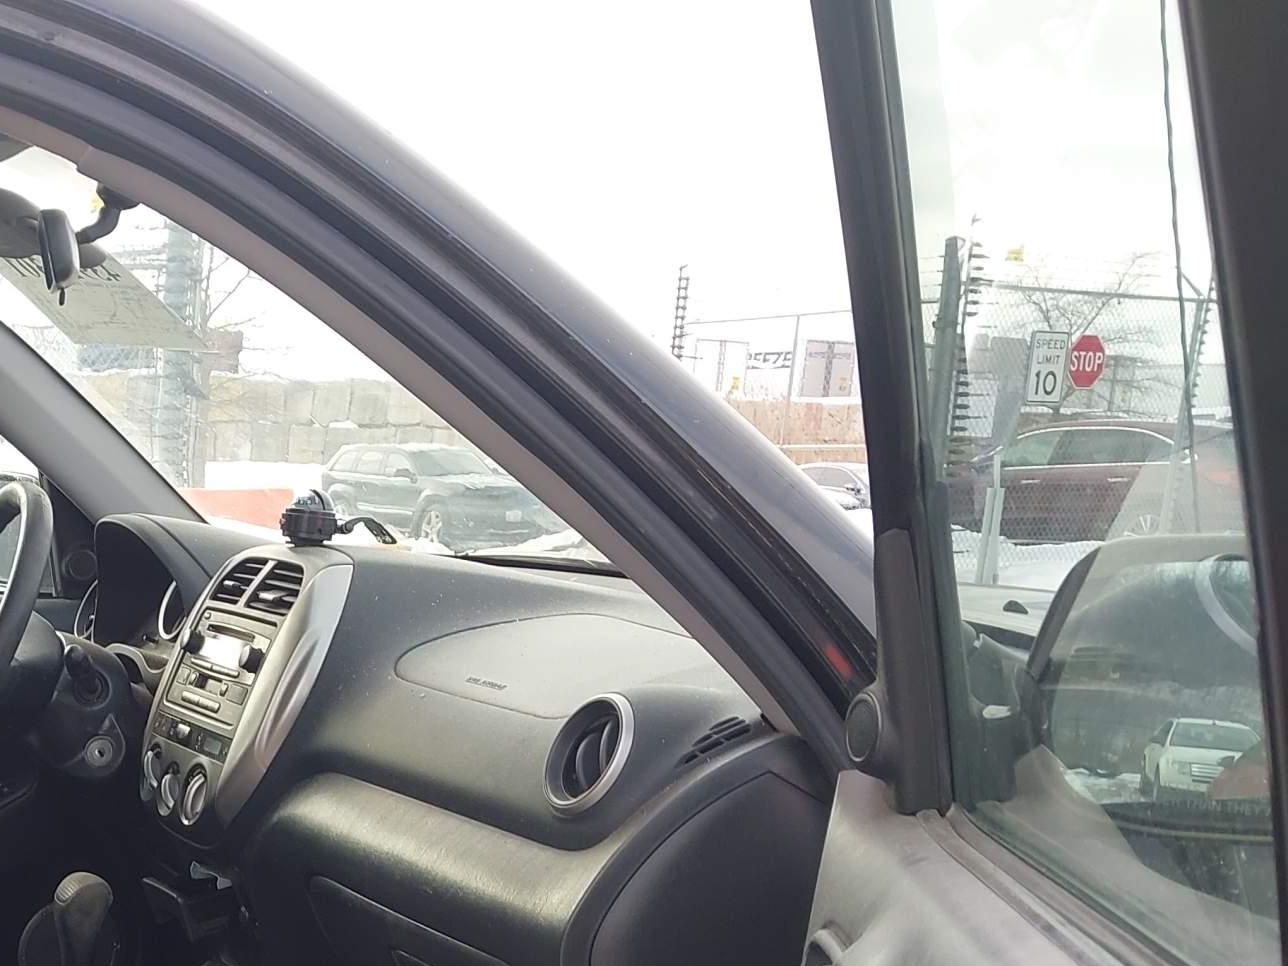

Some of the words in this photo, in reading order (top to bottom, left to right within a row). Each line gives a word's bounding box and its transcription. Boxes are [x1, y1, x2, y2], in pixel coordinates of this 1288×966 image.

[1035, 339, 1066, 350] SPEED
[1036, 354, 1061, 365] LIMIT
[1070, 351, 1104, 372] STOP
[1034, 369, 1058, 396] 10
